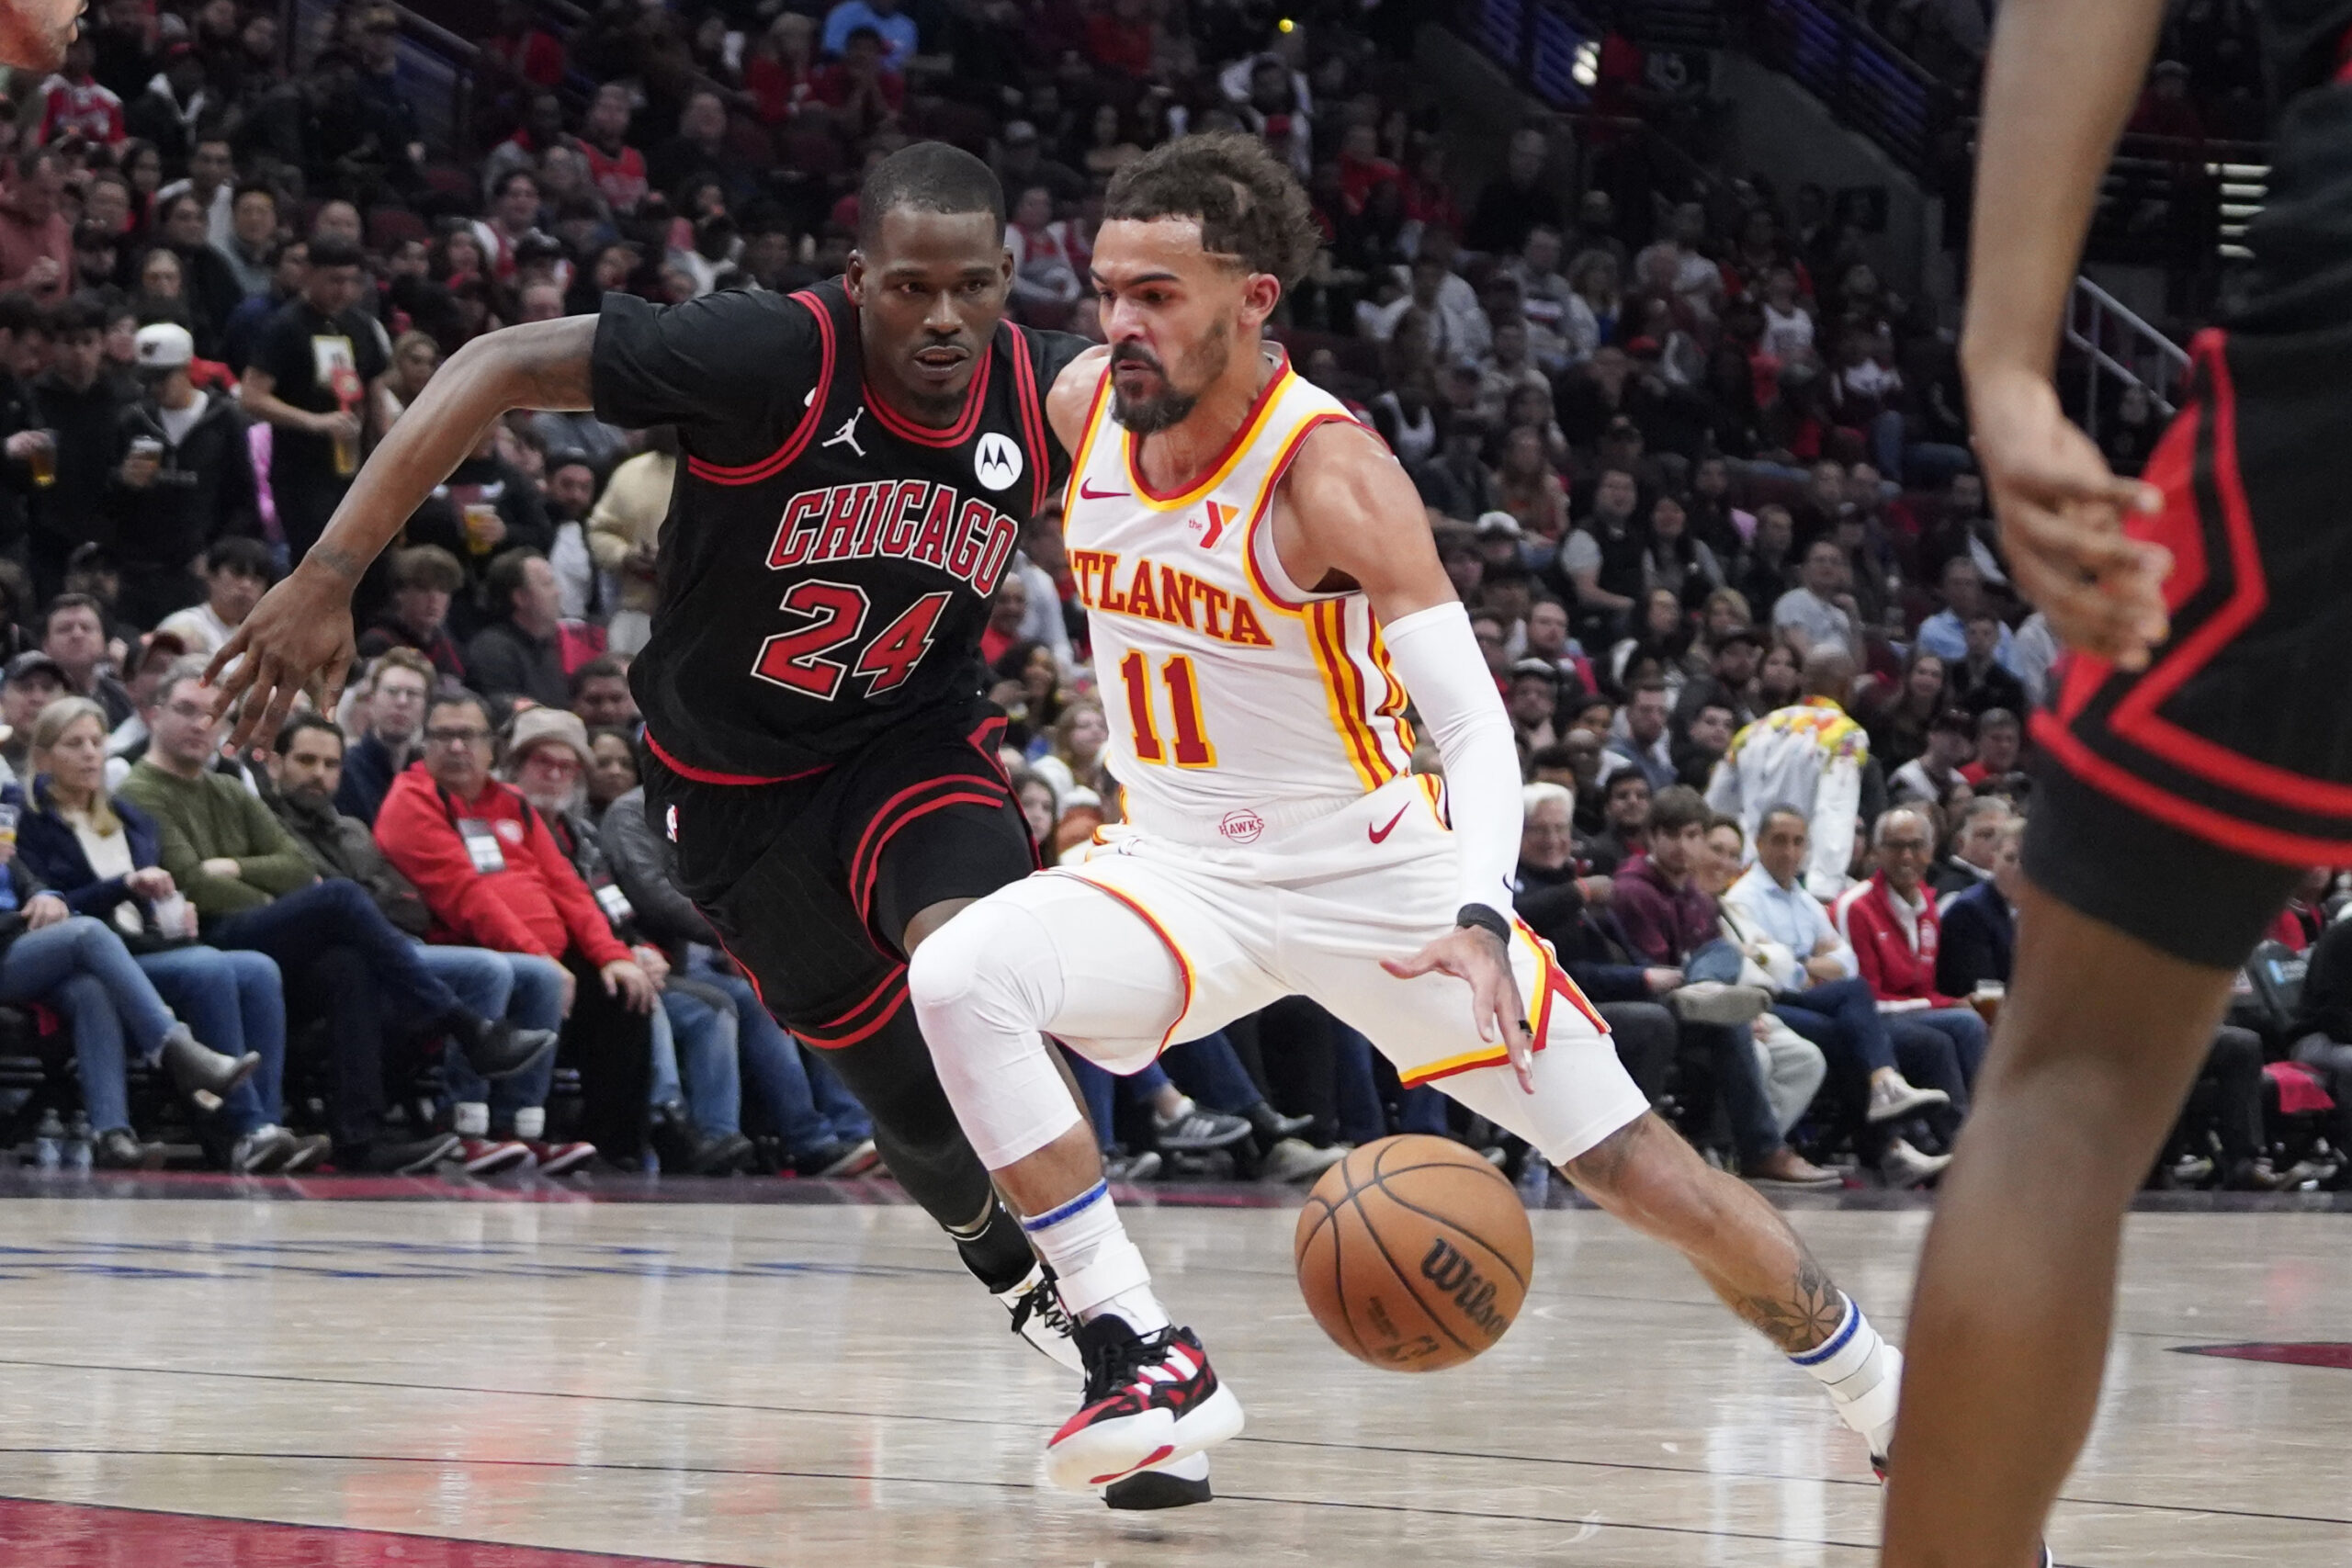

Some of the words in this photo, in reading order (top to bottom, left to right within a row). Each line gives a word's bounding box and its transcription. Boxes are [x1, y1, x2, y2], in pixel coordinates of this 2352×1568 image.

[765, 479, 1019, 598] CHICAGO
[1065, 547, 1274, 649] TLANTA
[750, 579, 954, 701] 24
[1119, 648, 1218, 769] 11
[1218, 818, 1265, 835] HAWKS
